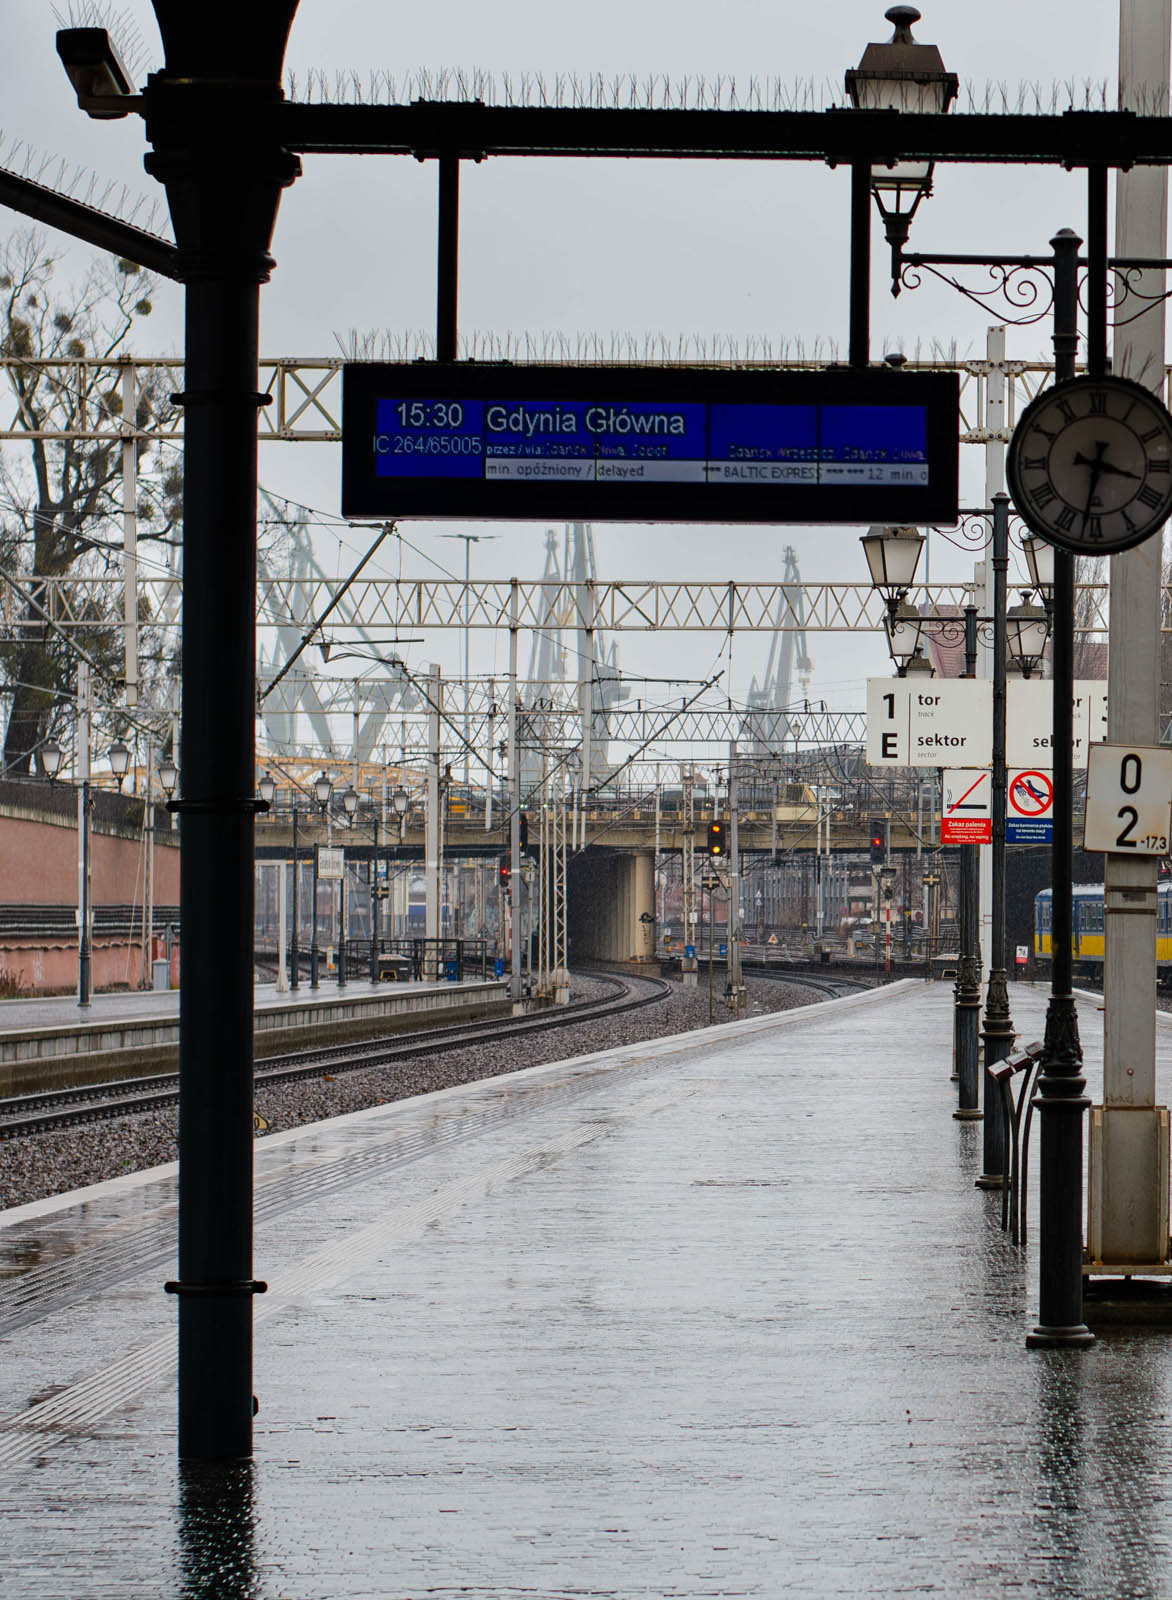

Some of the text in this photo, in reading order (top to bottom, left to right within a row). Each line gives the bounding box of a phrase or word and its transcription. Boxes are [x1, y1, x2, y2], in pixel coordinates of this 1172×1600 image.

[397, 403, 463, 427] 15:30
[486, 407, 686, 437] Gdynia Główna
[372, 435, 482, 455] IC 264/65005
[517, 461, 582, 477] opóźniony
[597, 464, 645, 478] delayed
[723, 465, 768, 479] BALTIC
[771, 466, 823, 480] EXPRESS
[868, 467, 884, 480] 12
[882, 693, 896, 720] 1
[917, 694, 942, 706] tor
[917, 710, 935, 718] track
[881, 732, 899, 759] E
[917, 733, 967, 747] sektor
[1119, 753, 1142, 795] 0
[1115, 805, 1139, 848] 2
